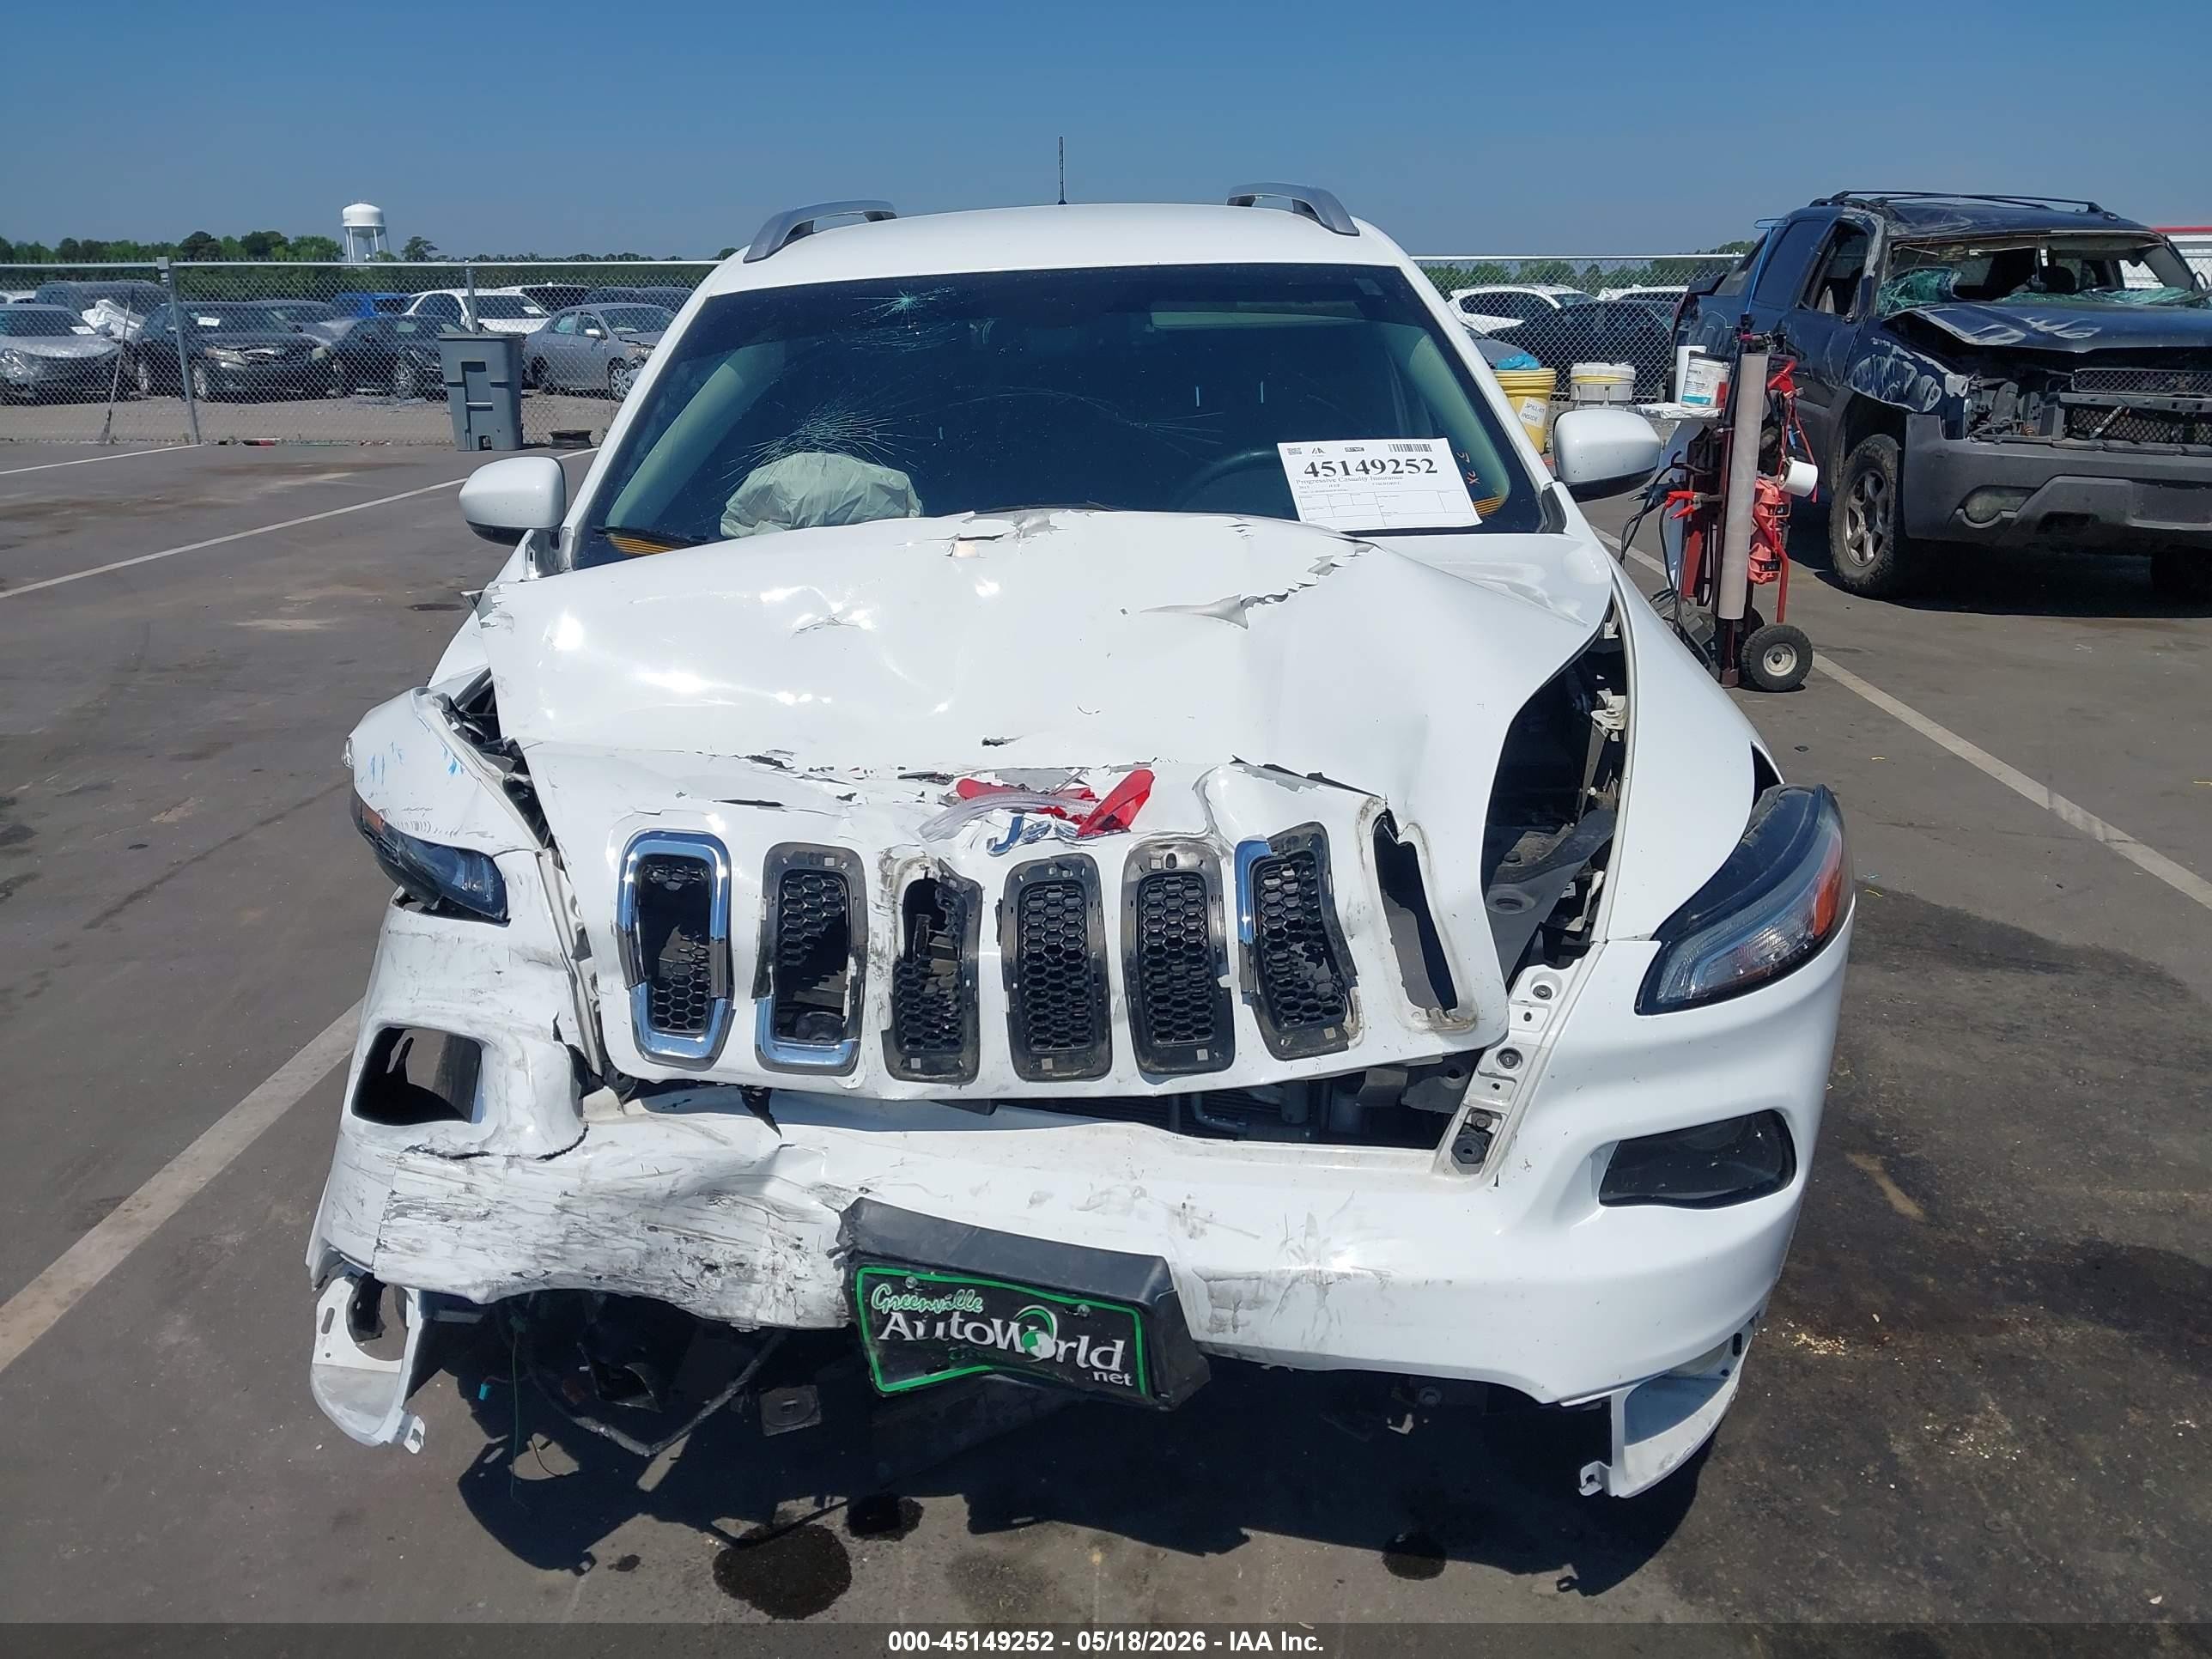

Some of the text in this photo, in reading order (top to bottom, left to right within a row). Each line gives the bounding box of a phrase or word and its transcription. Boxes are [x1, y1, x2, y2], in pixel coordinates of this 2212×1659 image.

[1304, 458, 1438, 477] 45149252
[1296, 477, 1337, 486] Progressive
[870, 1282, 985, 1314] Greenville
[877, 1304, 1126, 1372] AutoWorld
